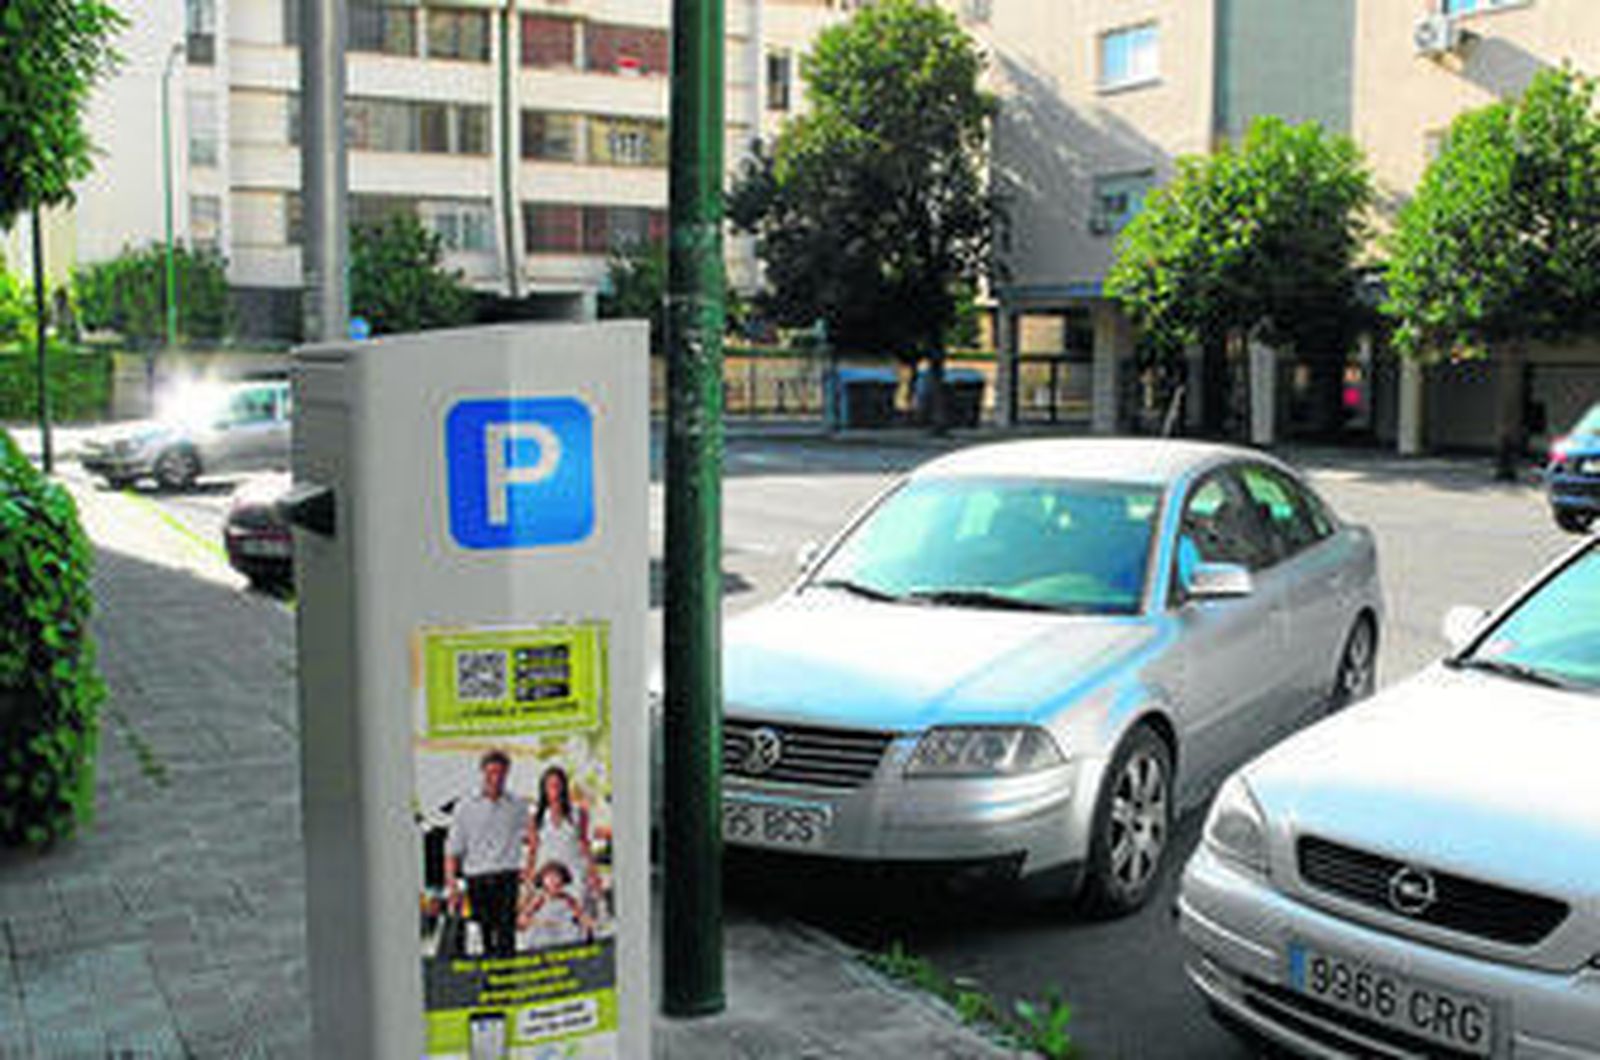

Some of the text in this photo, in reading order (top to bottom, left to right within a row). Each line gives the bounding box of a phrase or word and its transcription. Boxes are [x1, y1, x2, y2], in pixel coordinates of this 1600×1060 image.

[486, 421, 562, 526] P
[1311, 957, 1484, 1046] 9966 CRG
